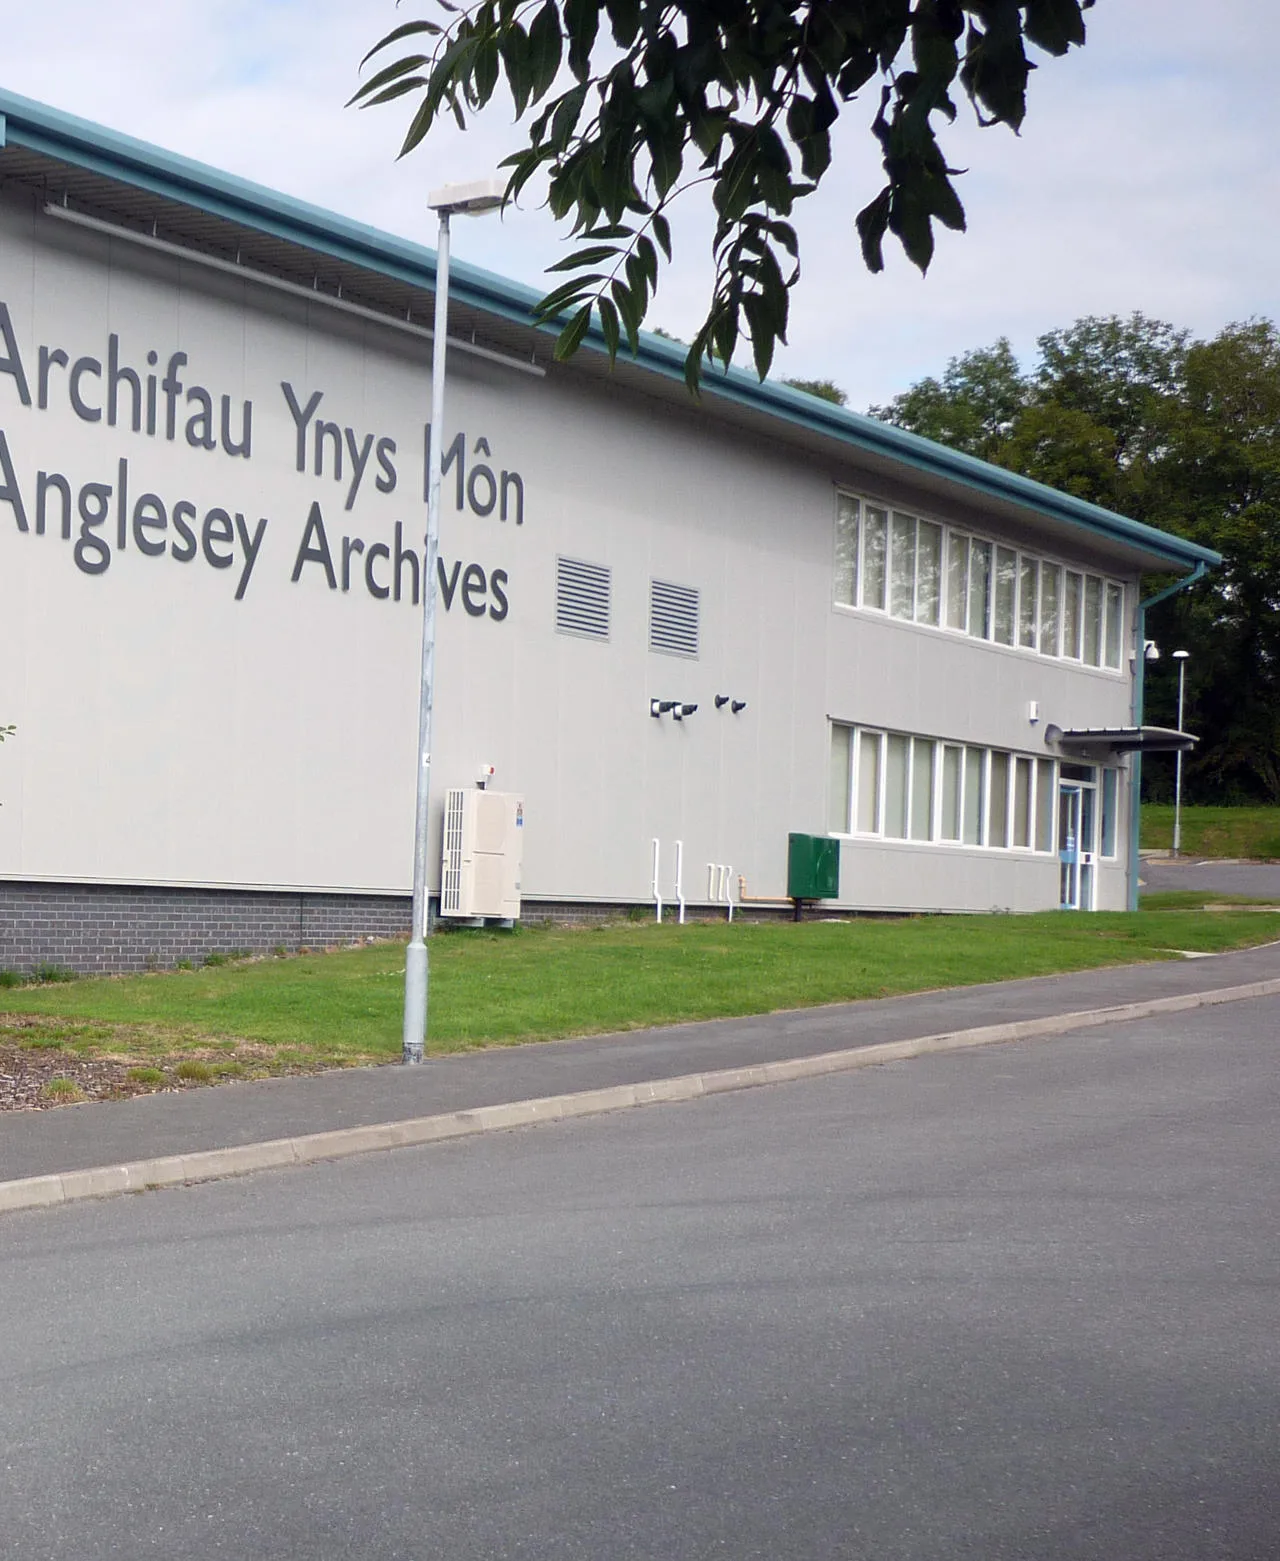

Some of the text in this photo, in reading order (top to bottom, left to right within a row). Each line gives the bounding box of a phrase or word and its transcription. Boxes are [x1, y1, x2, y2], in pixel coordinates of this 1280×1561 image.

[280, 381, 397, 511] Ynys
[423, 422, 524, 526] Môn
[291, 501, 509, 622] Archves
